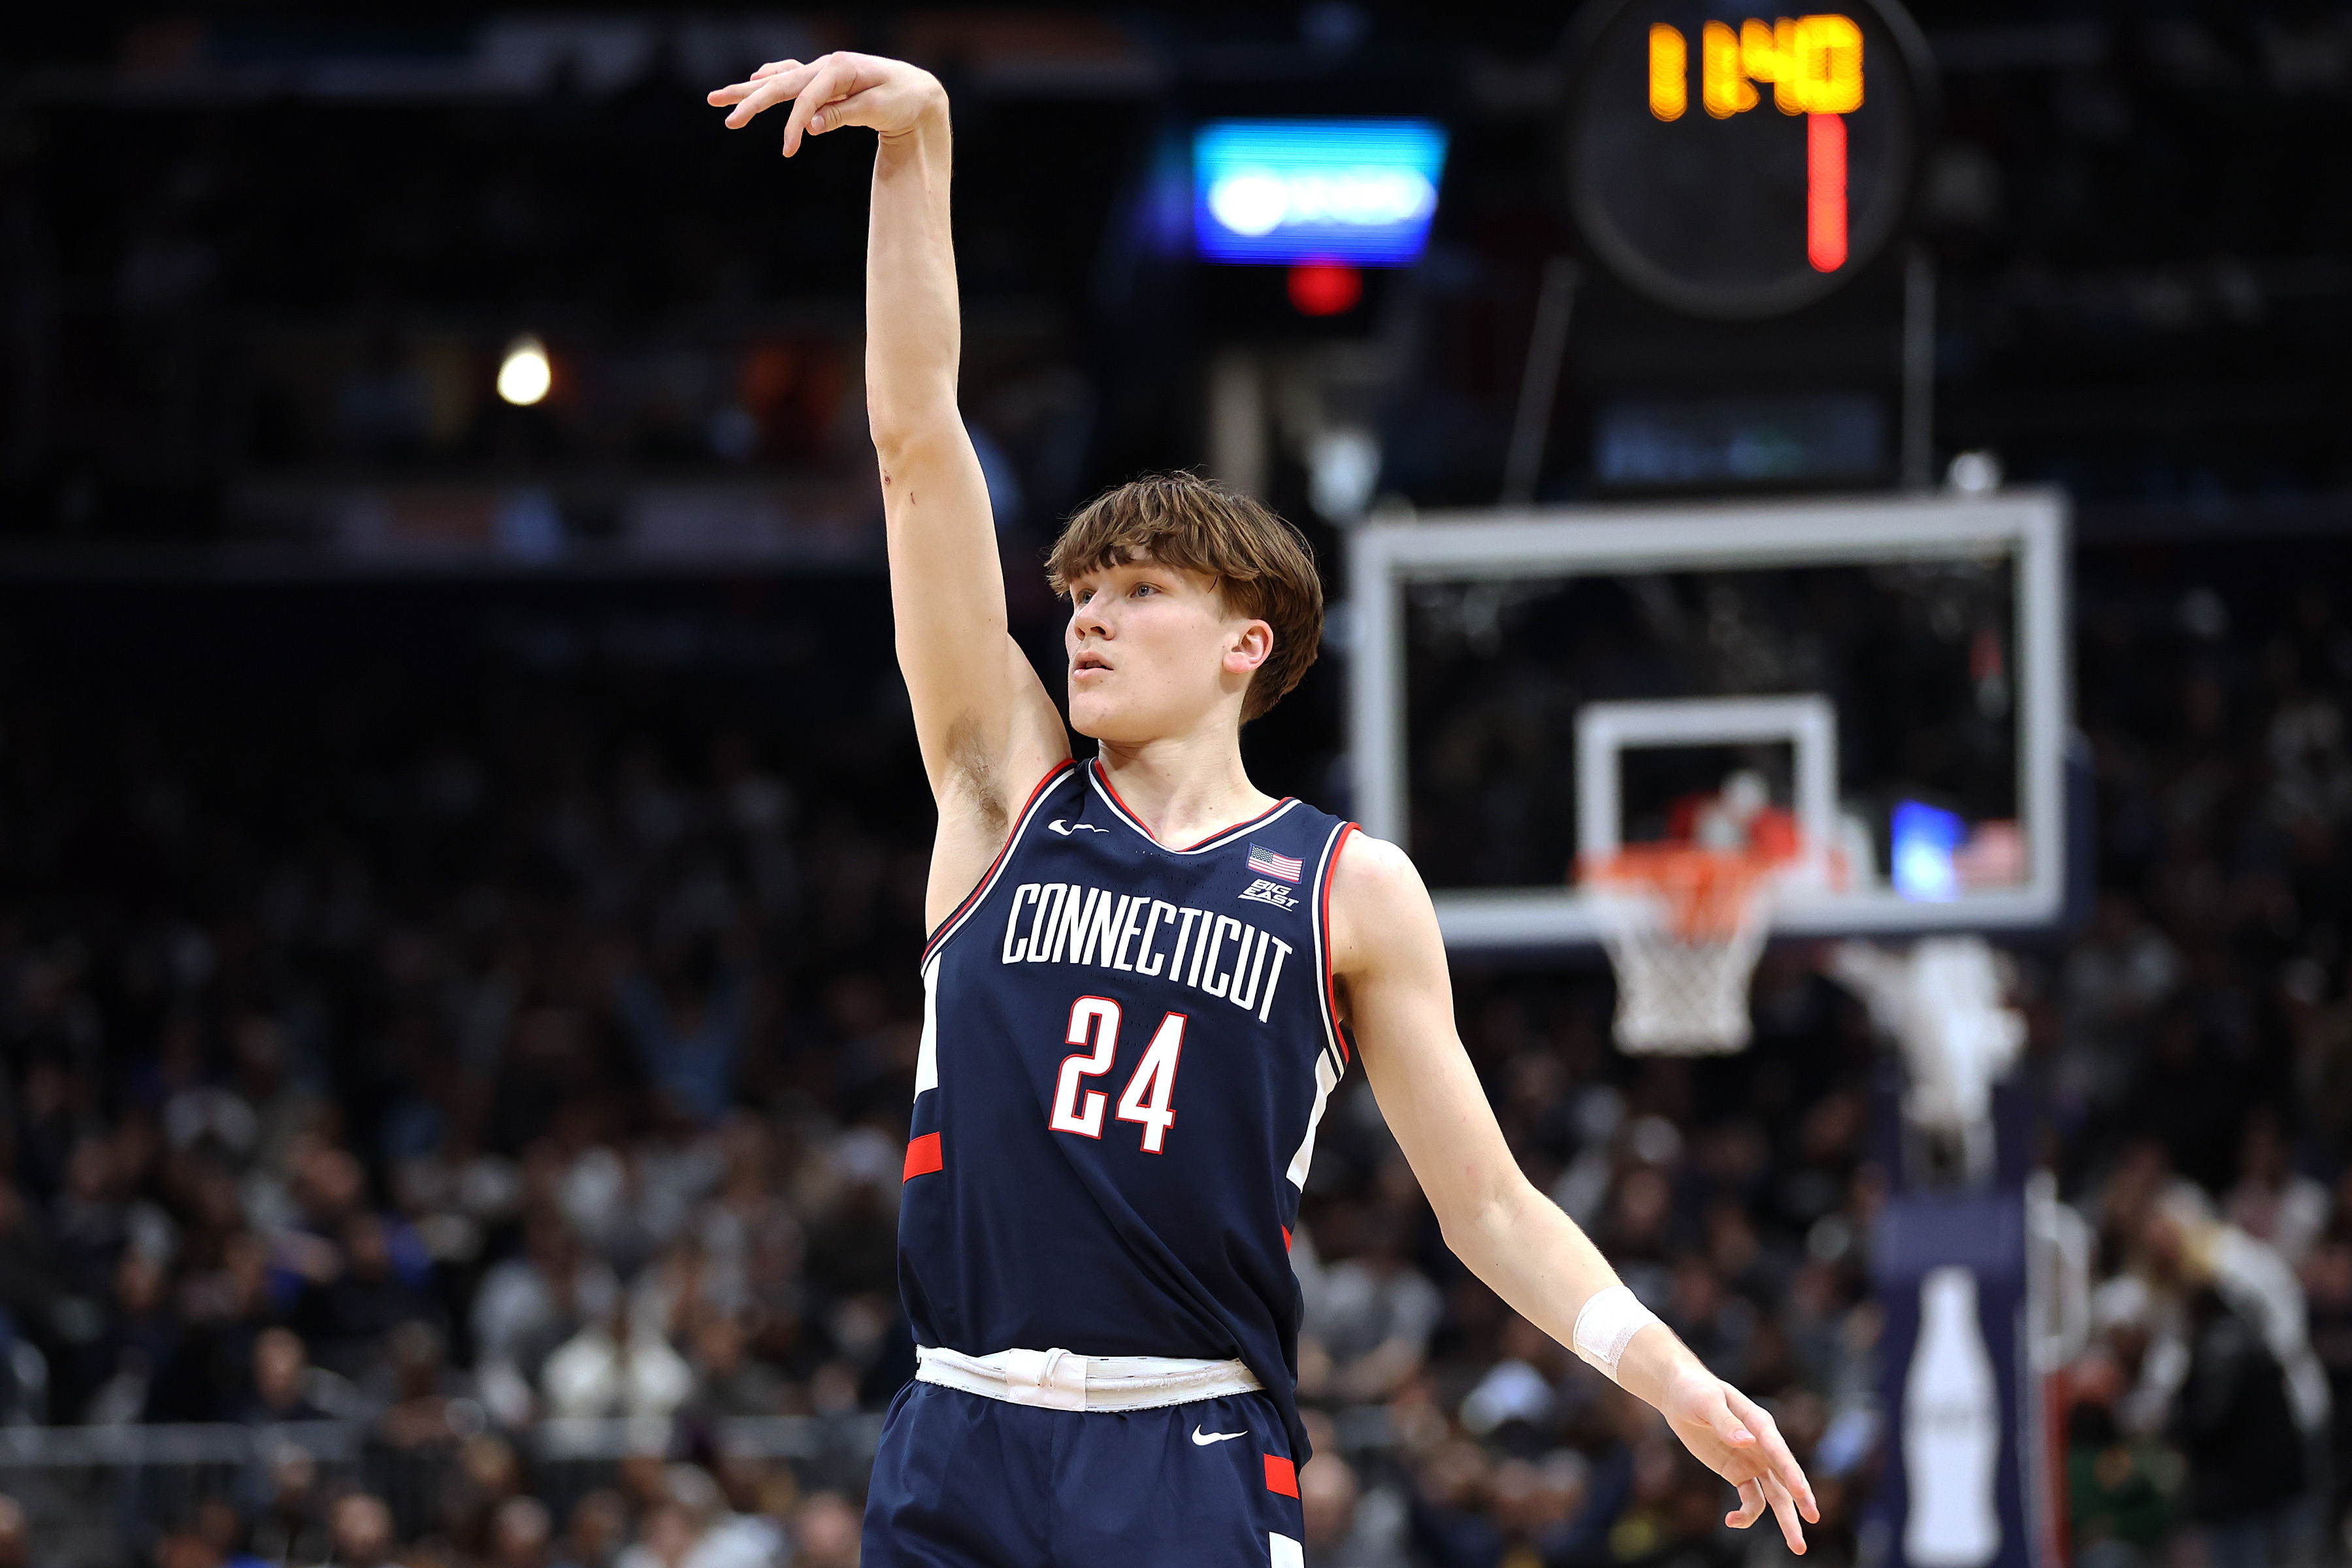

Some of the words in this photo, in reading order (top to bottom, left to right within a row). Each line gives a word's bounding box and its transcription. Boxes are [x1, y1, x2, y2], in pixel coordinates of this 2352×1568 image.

[1243, 886, 1299, 907] EAST
[1250, 879, 1292, 895] BIG
[1002, 883, 1293, 1023] CONNECTICUT
[1048, 995, 1188, 1155] 24
